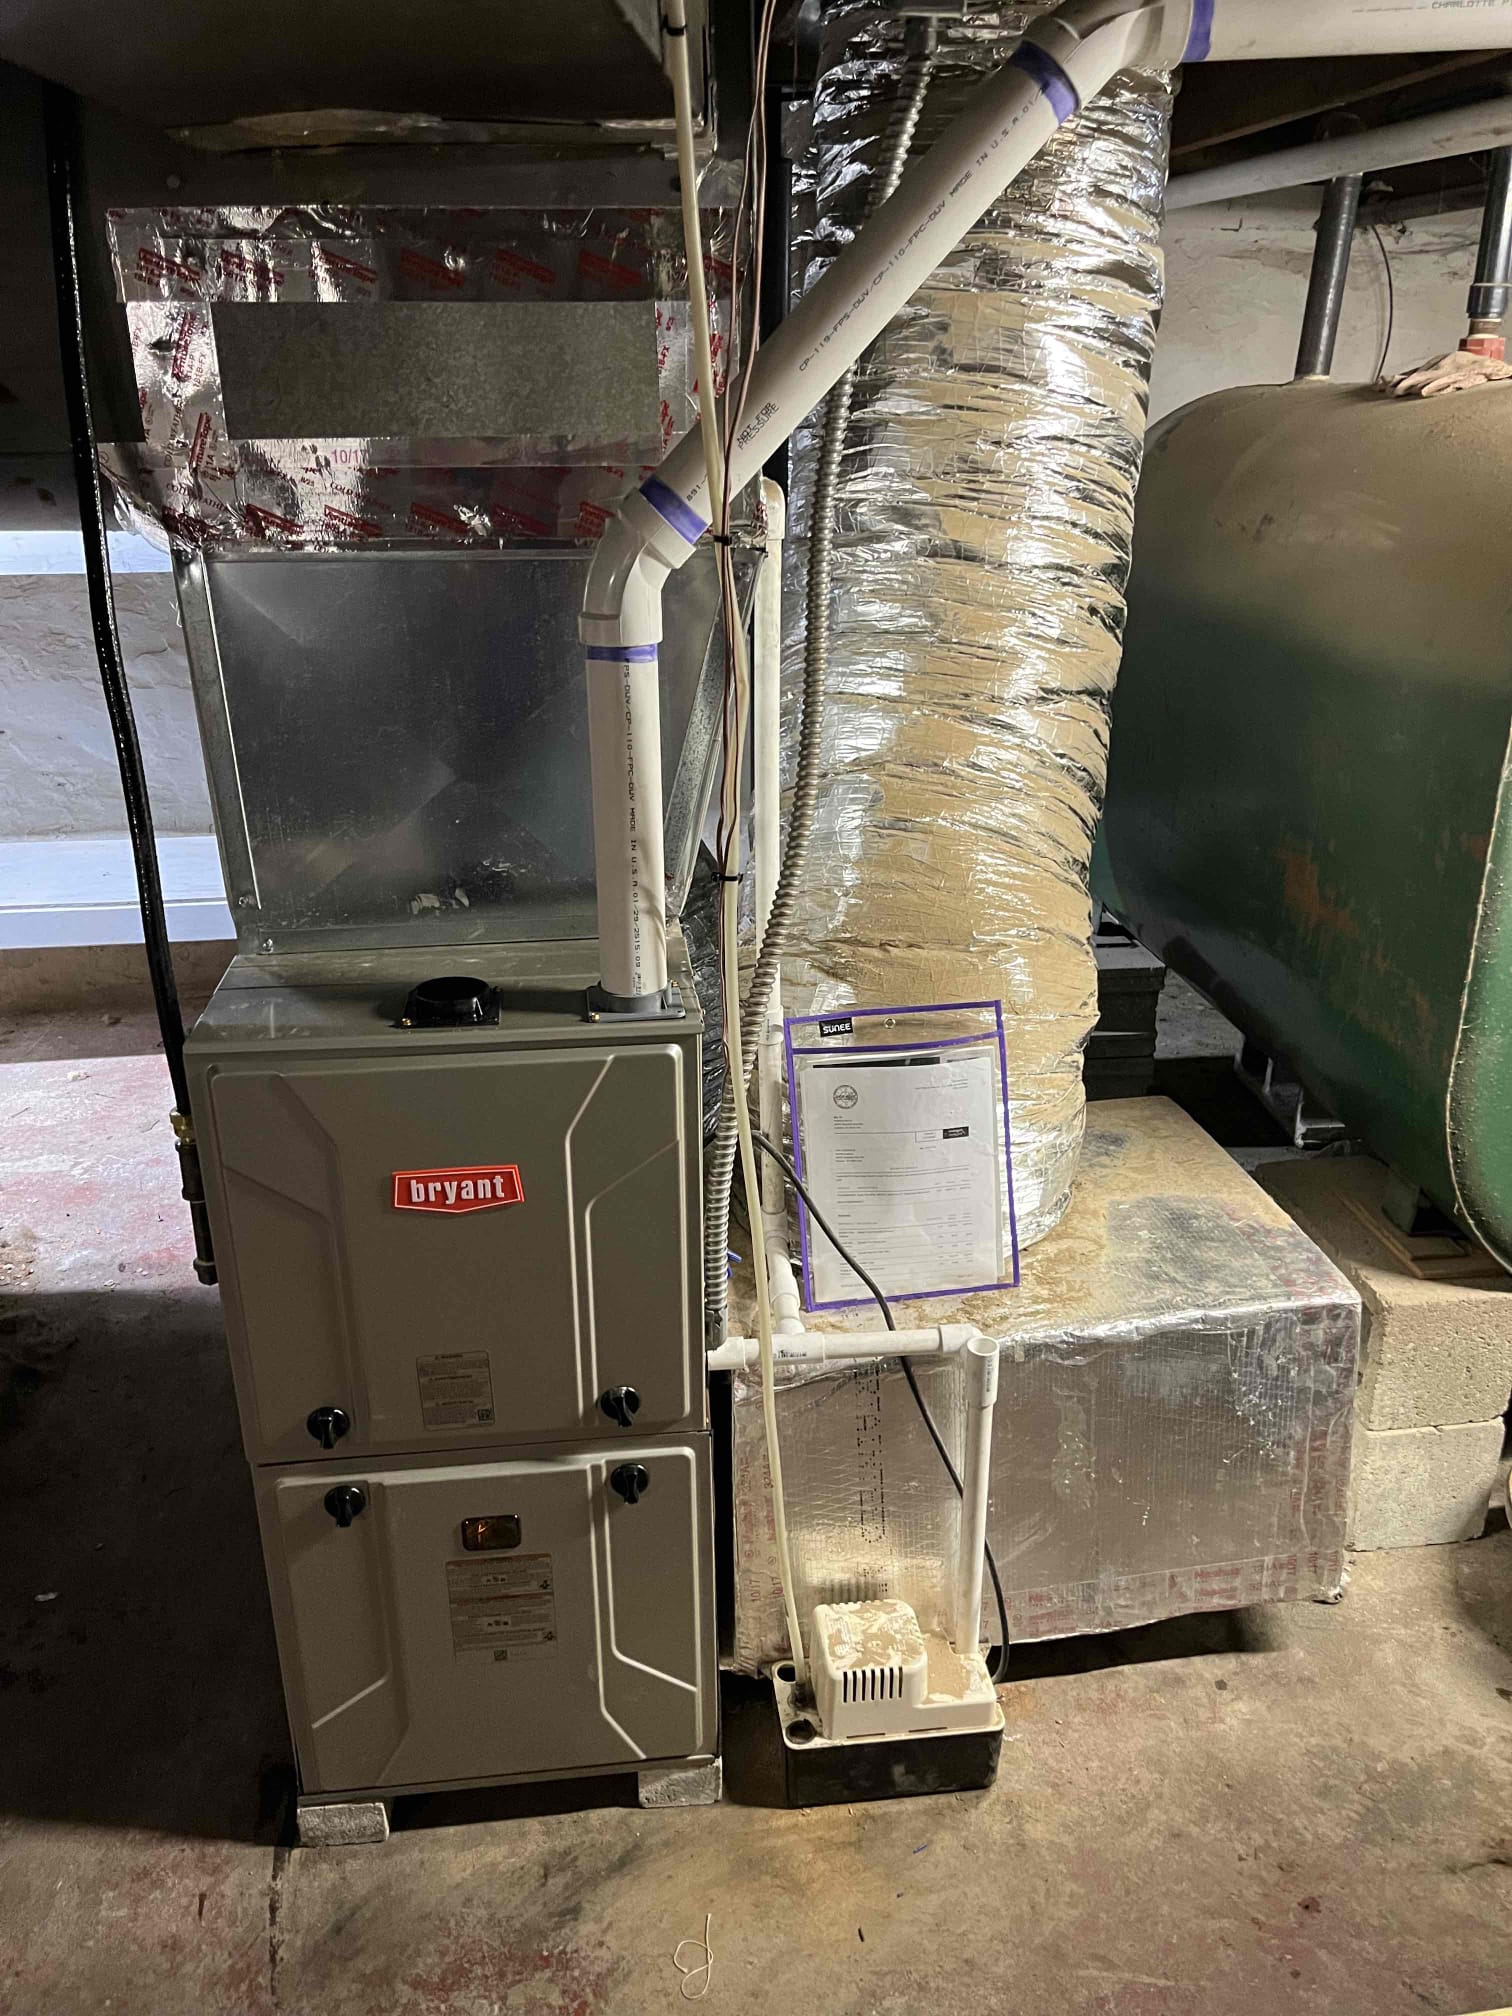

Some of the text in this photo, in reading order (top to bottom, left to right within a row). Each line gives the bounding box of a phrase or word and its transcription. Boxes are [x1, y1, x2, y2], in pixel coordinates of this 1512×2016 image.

[949, 170, 973, 198] MADE
[976, 152, 990, 167] IN
[737, 402, 772, 442] NOT FOR
[738, 403, 780, 450] PRESSURE
[628, 805, 637, 833] MADE
[630, 840, 639, 852] IN
[410, 1175, 505, 1205] bryant
